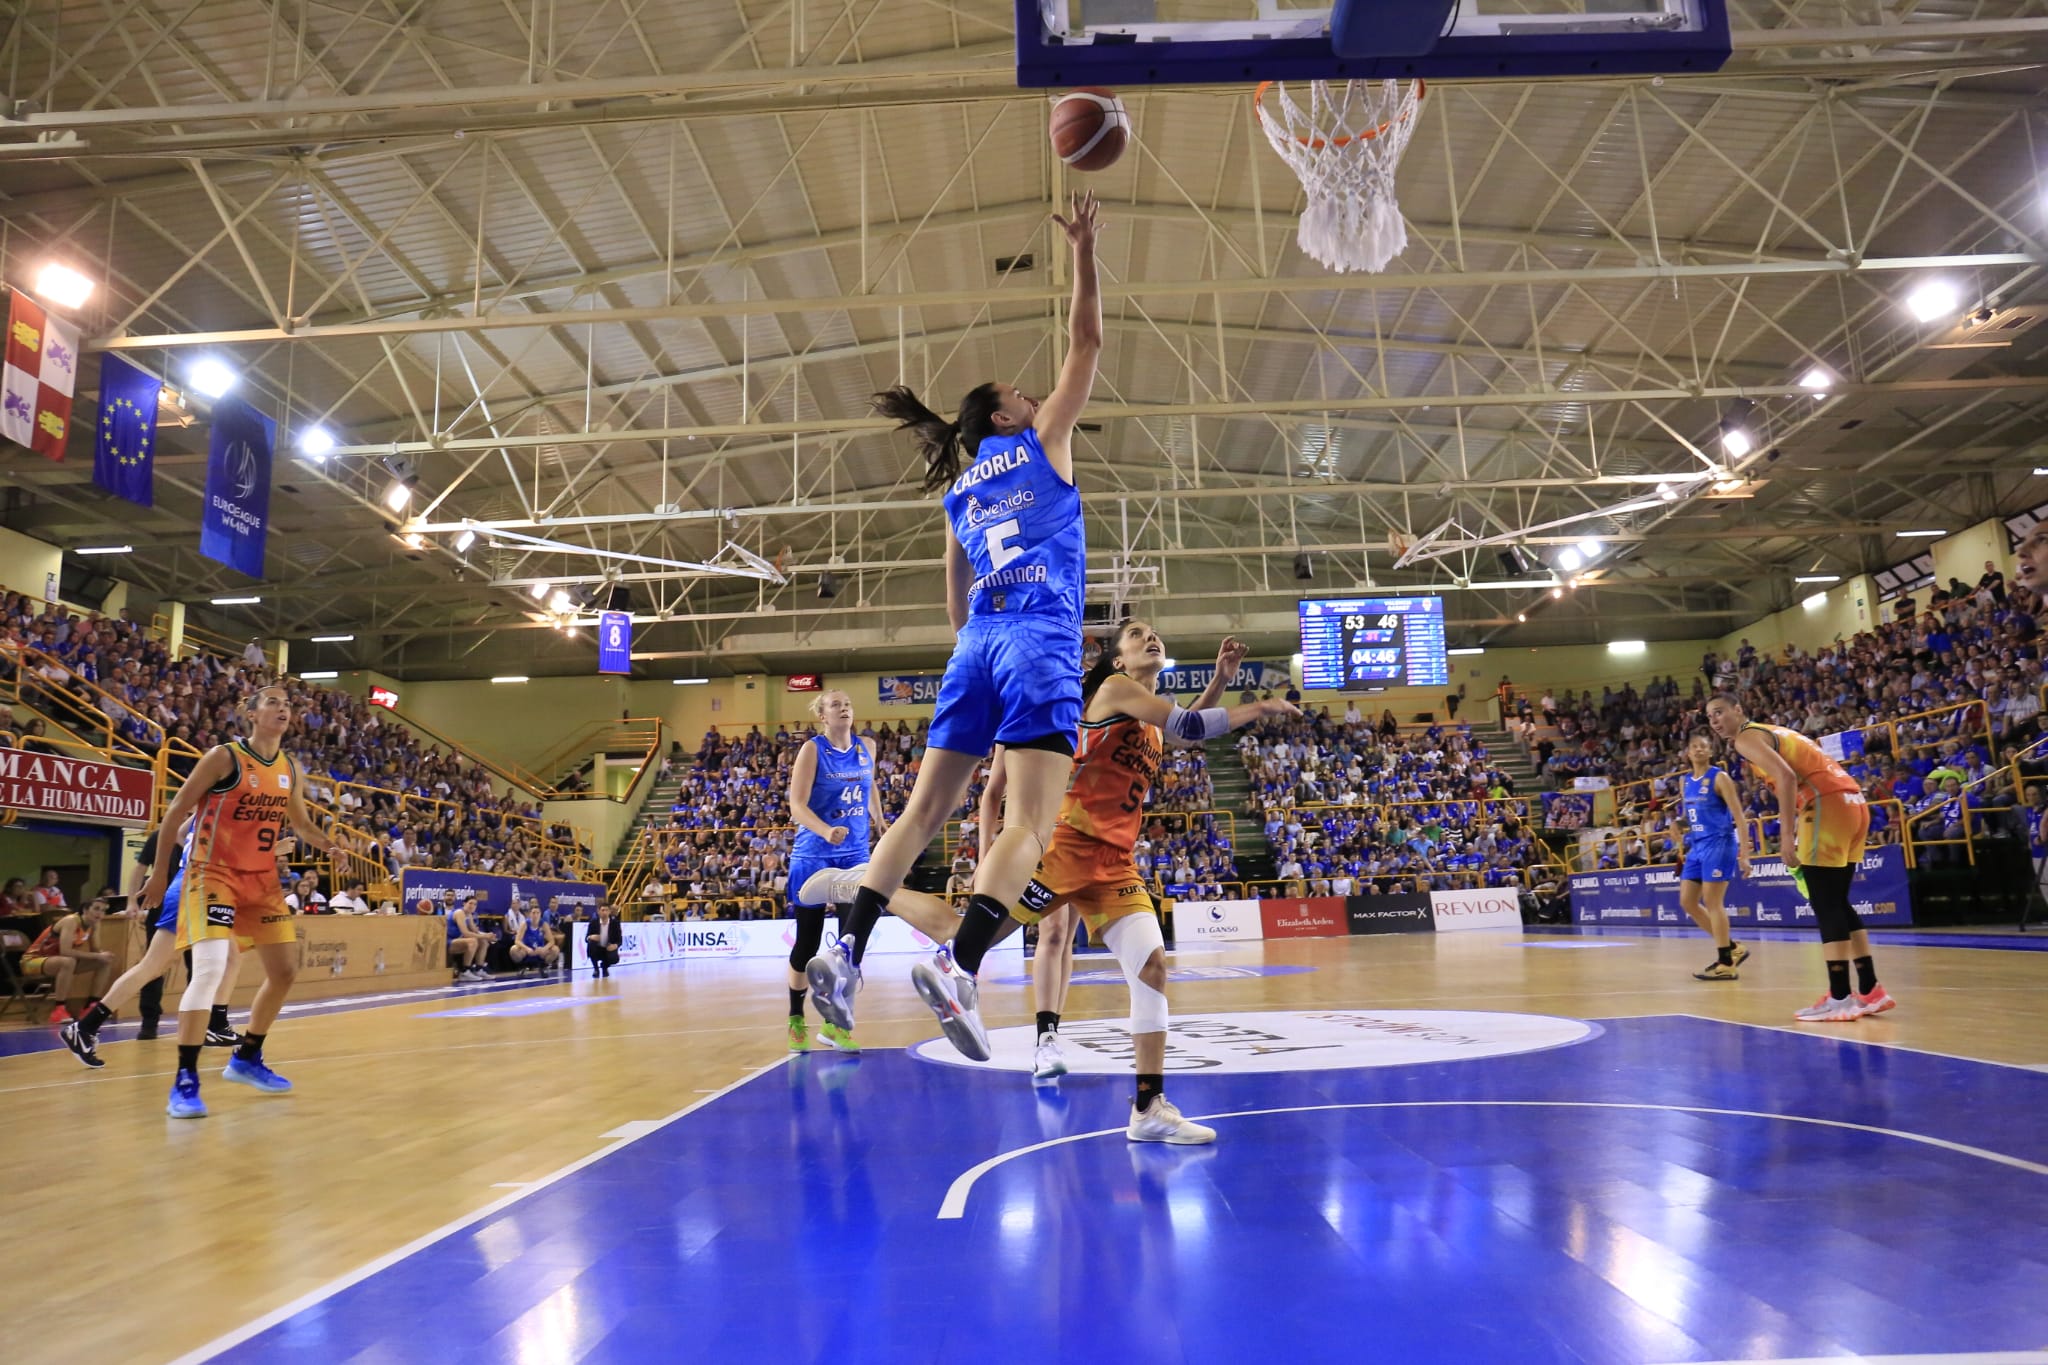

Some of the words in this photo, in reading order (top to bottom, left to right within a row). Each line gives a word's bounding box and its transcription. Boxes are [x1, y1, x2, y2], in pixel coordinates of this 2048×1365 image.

[953, 445, 1030, 495] CAZORLA
[1345, 615, 1365, 630] 53
[1378, 614, 1398, 629] 46
[610, 625, 621, 647] 8
[1352, 649, 1396, 664] 04:46
[1164, 671, 1186, 689] DE
[1387, 666, 1396, 678] 2
[11, 784, 36, 806] LA
[41, 787, 146, 818] HUMANIDAD
[841, 784, 863, 805] 44
[1120, 781, 1144, 813] 5
[257, 828, 275, 852] 9
[1862, 854, 1884, 870] LEÓN
[1378, 910, 1417, 918] FACTOR
[1435, 899, 1516, 917] REVLON
